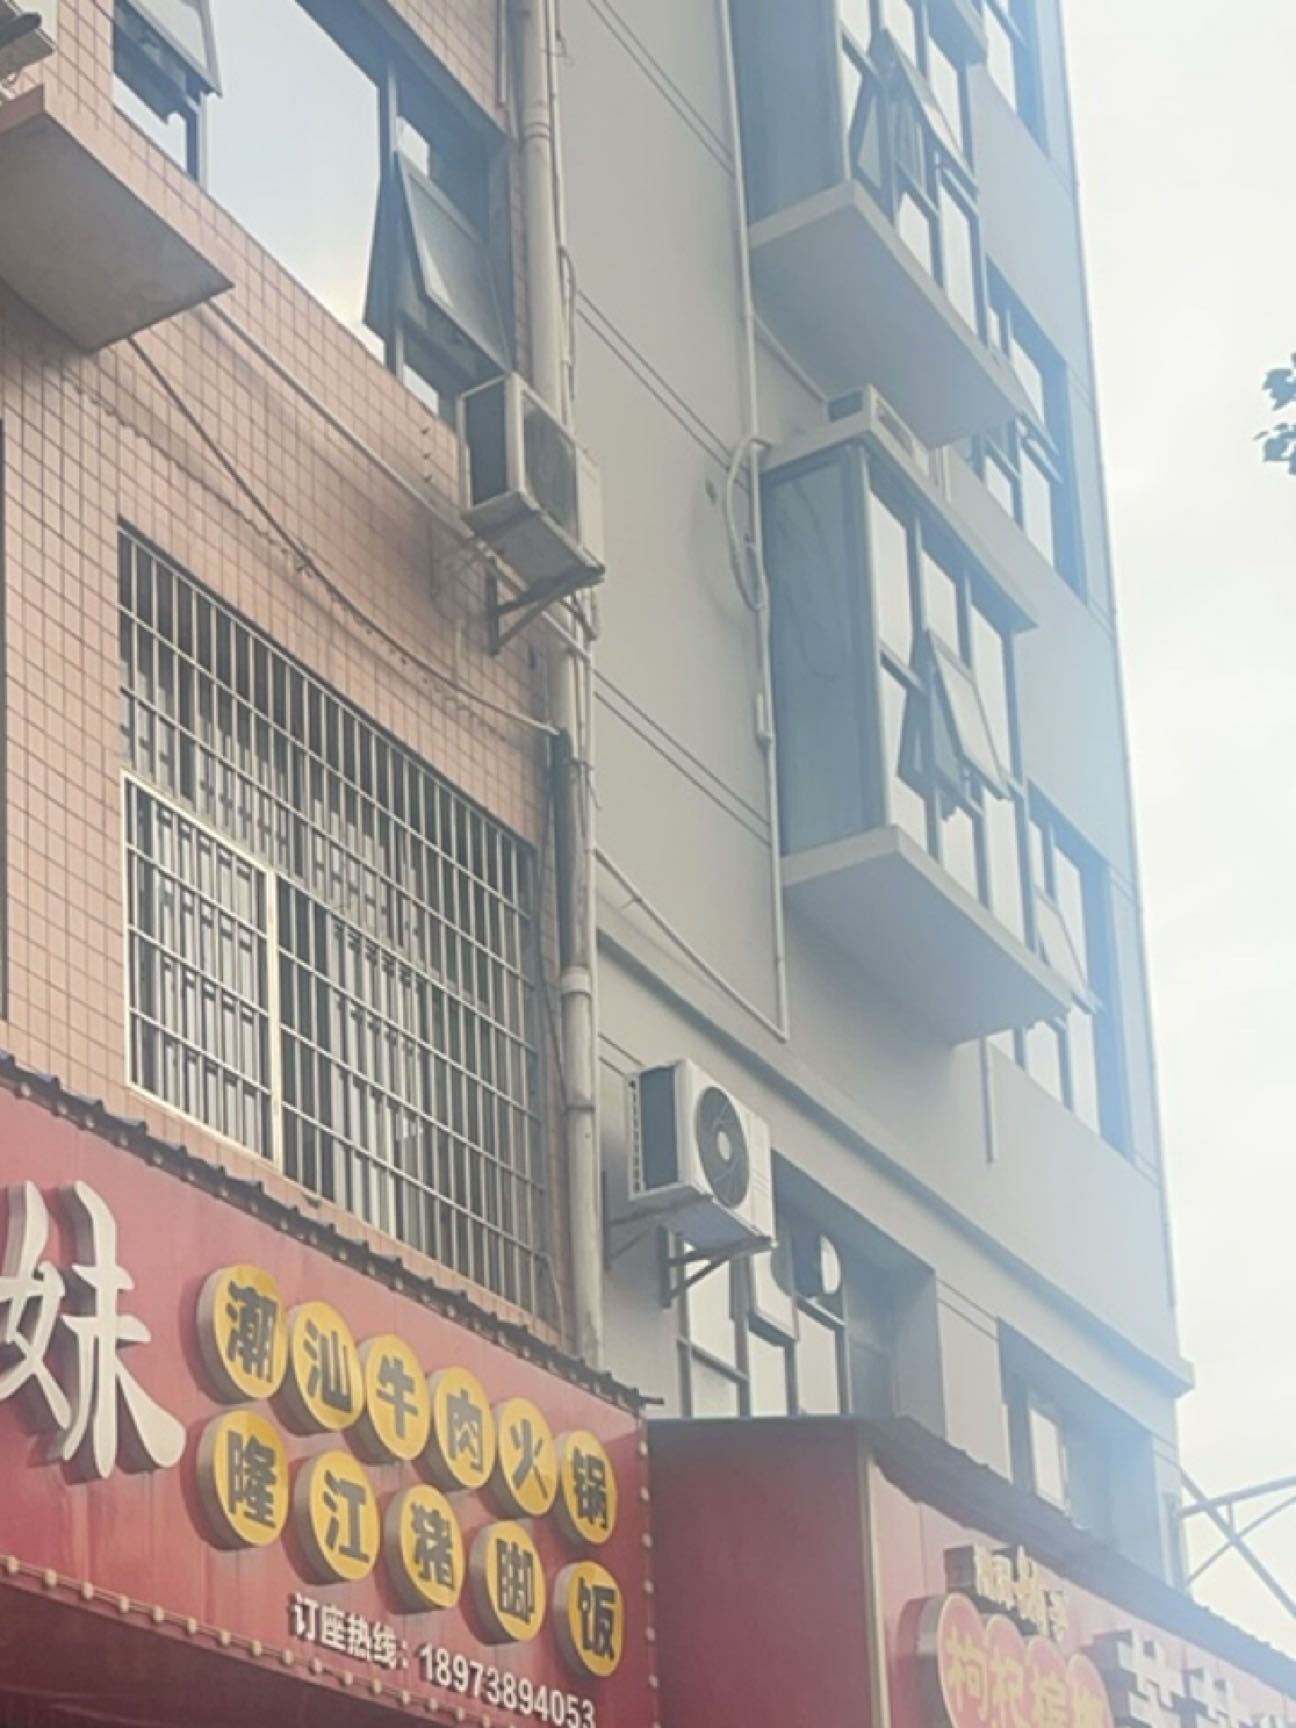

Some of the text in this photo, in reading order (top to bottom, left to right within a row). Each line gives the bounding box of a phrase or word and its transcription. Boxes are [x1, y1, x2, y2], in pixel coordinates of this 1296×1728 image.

[224, 1280, 609, 1530] 潮汕牛肉火锅
[227, 1430, 615, 1660] 隆江猪脚饭
